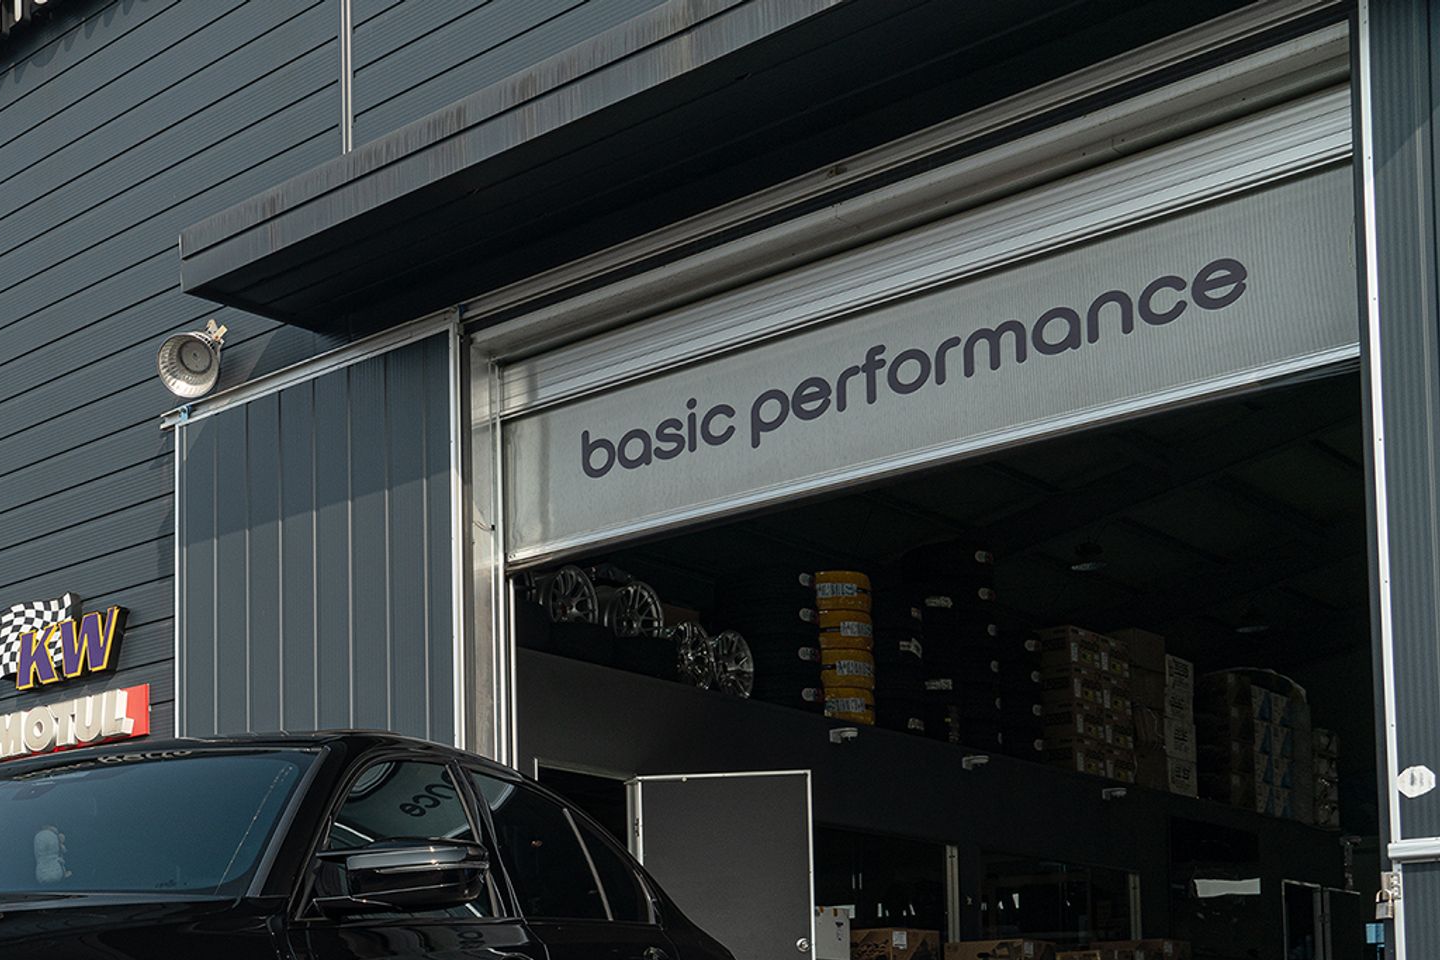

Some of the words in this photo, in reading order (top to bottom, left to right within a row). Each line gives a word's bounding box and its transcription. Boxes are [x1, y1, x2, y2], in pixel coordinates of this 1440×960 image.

[580, 398, 736, 479] basic
[750, 257, 1248, 449] performance
[16, 605, 121, 691] KW
